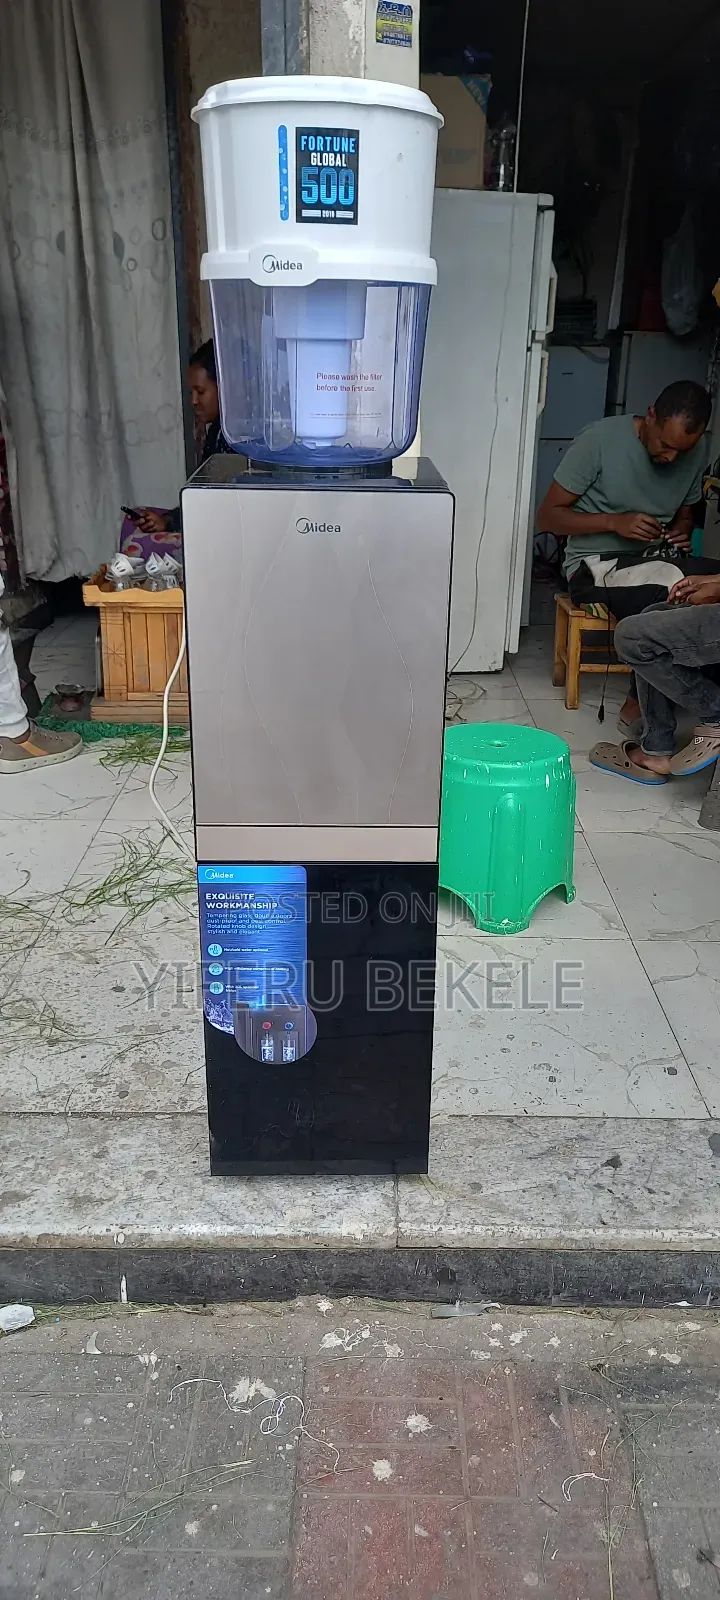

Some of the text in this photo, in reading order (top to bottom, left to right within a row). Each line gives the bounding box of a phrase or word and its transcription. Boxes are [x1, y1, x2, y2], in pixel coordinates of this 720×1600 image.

[301, 135, 356, 153] FORTUNE
[310, 152, 347, 167] GLOBAL
[301, 166, 355, 205] 500
[262, 254, 303, 273] Midea
[316, 372, 383, 381] Please wash the filter
[316, 384, 338, 392] before
[340, 384, 351, 392] the
[351, 384, 363, 393] first
[296, 517, 341, 534] Midea
[205, 868, 234, 880] Midea
[205, 892, 255, 900] EXQUISITE
